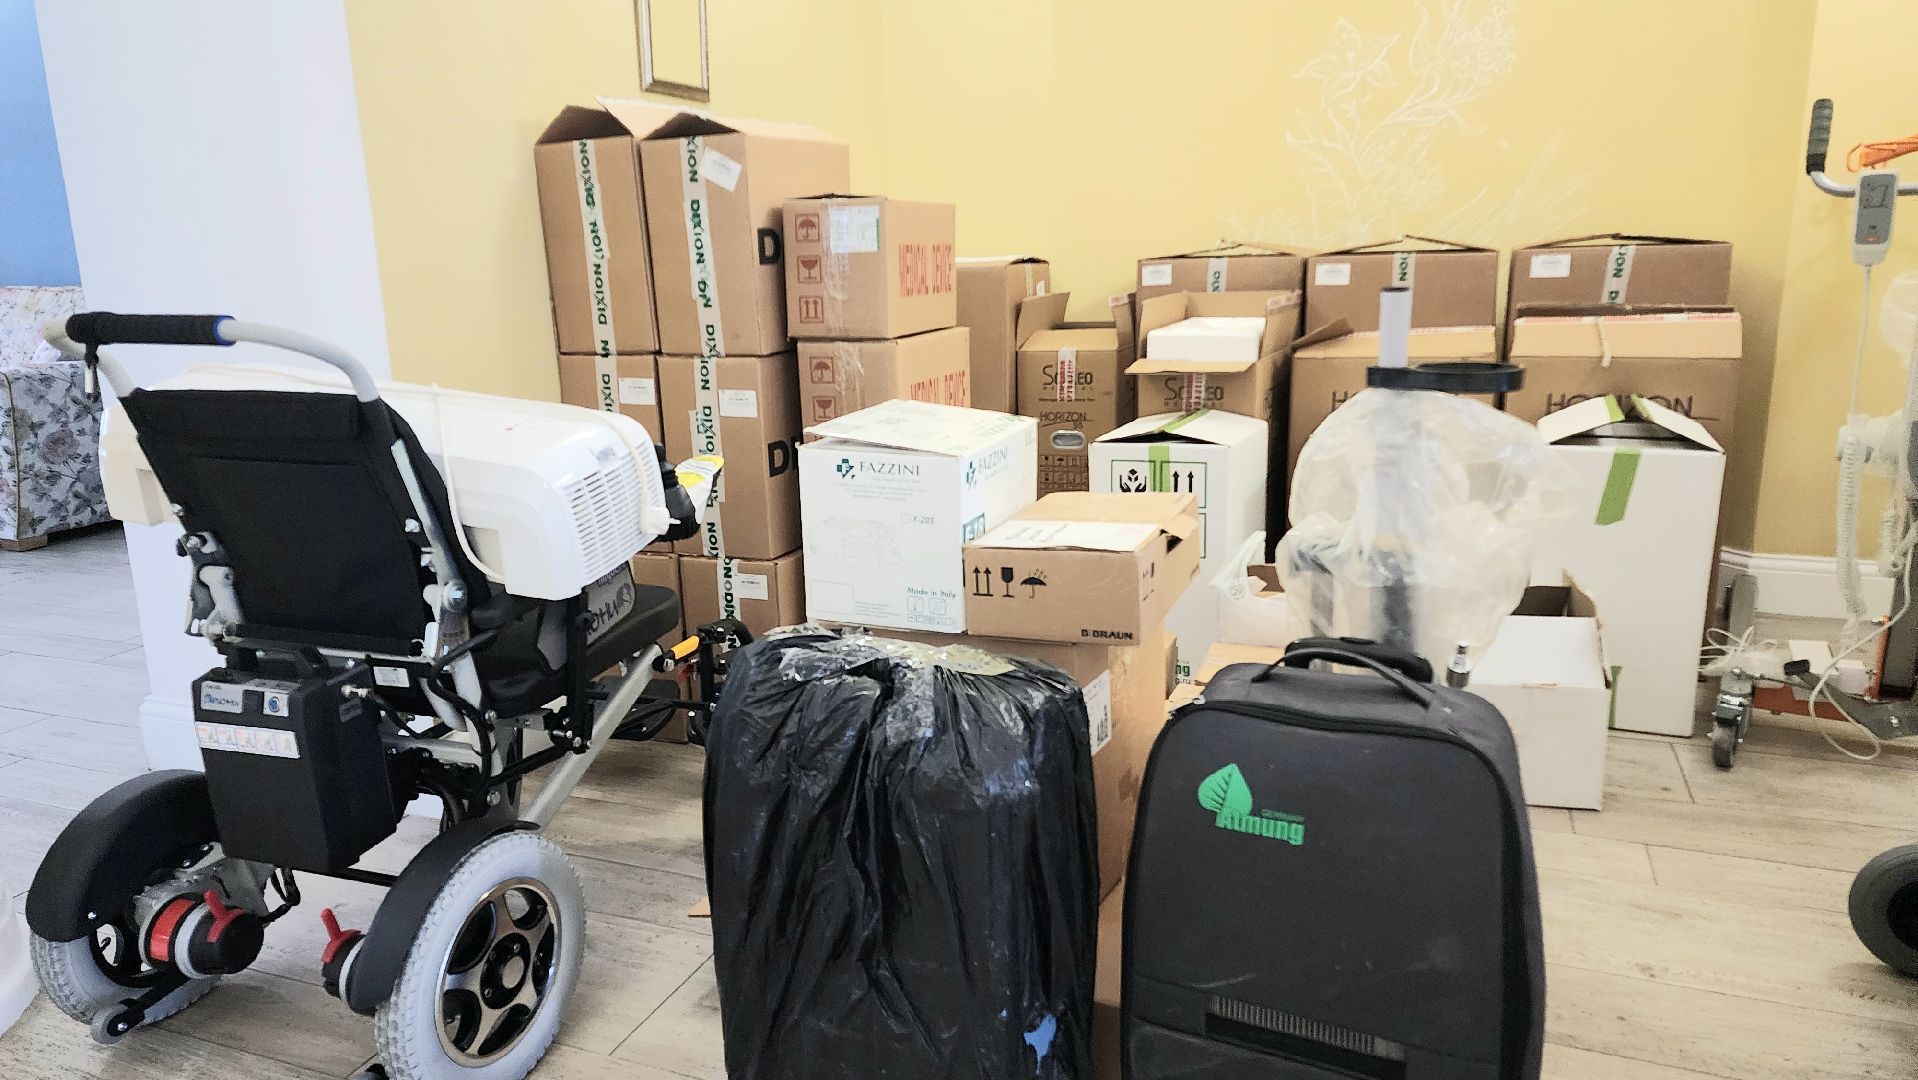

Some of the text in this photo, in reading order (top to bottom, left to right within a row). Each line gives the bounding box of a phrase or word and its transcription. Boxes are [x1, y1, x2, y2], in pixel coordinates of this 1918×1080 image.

[593, 263, 608, 325] DIXION
[1040, 410, 1088, 422] HORIZON
[978, 444, 1008, 474] FAZZINI
[860, 460, 920, 477] FAZZINI
[907, 586, 928, 596] Made
[940, 590, 956, 600] Italy
[1174, 664, 1190, 677] ng
